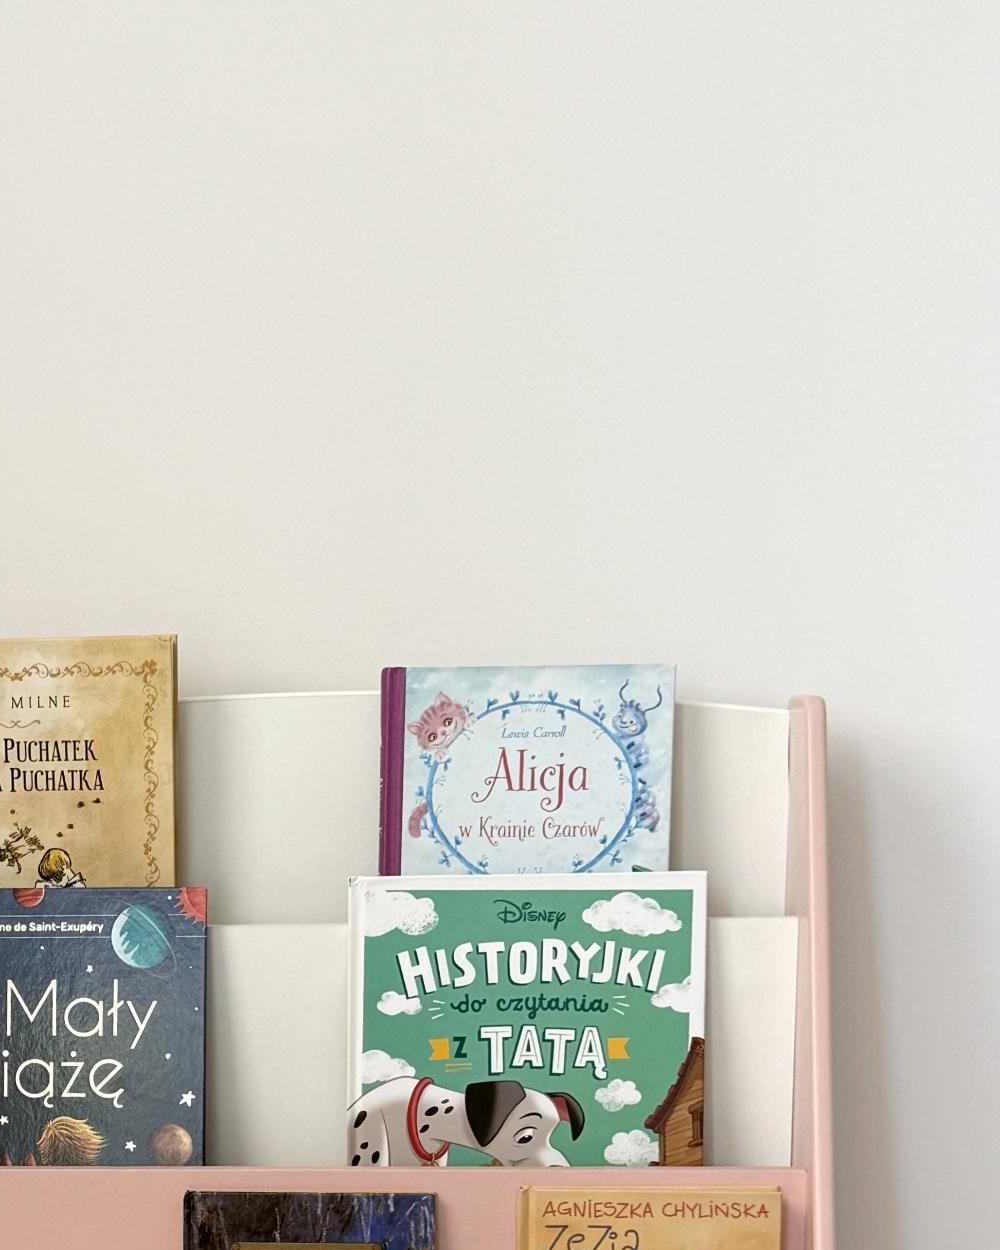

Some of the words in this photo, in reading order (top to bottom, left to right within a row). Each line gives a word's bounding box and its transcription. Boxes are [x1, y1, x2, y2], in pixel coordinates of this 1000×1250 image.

[11, 695, 72, 709] MILNE
[501, 727, 529, 738] Lewis
[533, 725, 567, 738] Carroll
[3, 738, 98, 763] PUCHATEK
[10, 767, 105, 792] PUCHATKA
[471, 747, 589, 812] Alicja
[458, 825, 472, 838] w
[479, 816, 536, 846] Krainie
[542, 816, 605, 839] Czarów
[13, 922, 27, 932] de
[28, 921, 104, 934] Saint-Exupéry
[396, 938, 666, 999] HISTORYJKI
[6, 978, 158, 1050] Mały
[450, 993, 486, 1013] do
[496, 993, 609, 1020] czytania
[478, 1024, 608, 1080] TATĄ
[542, 1199, 654, 1219] AGNIESZKA
